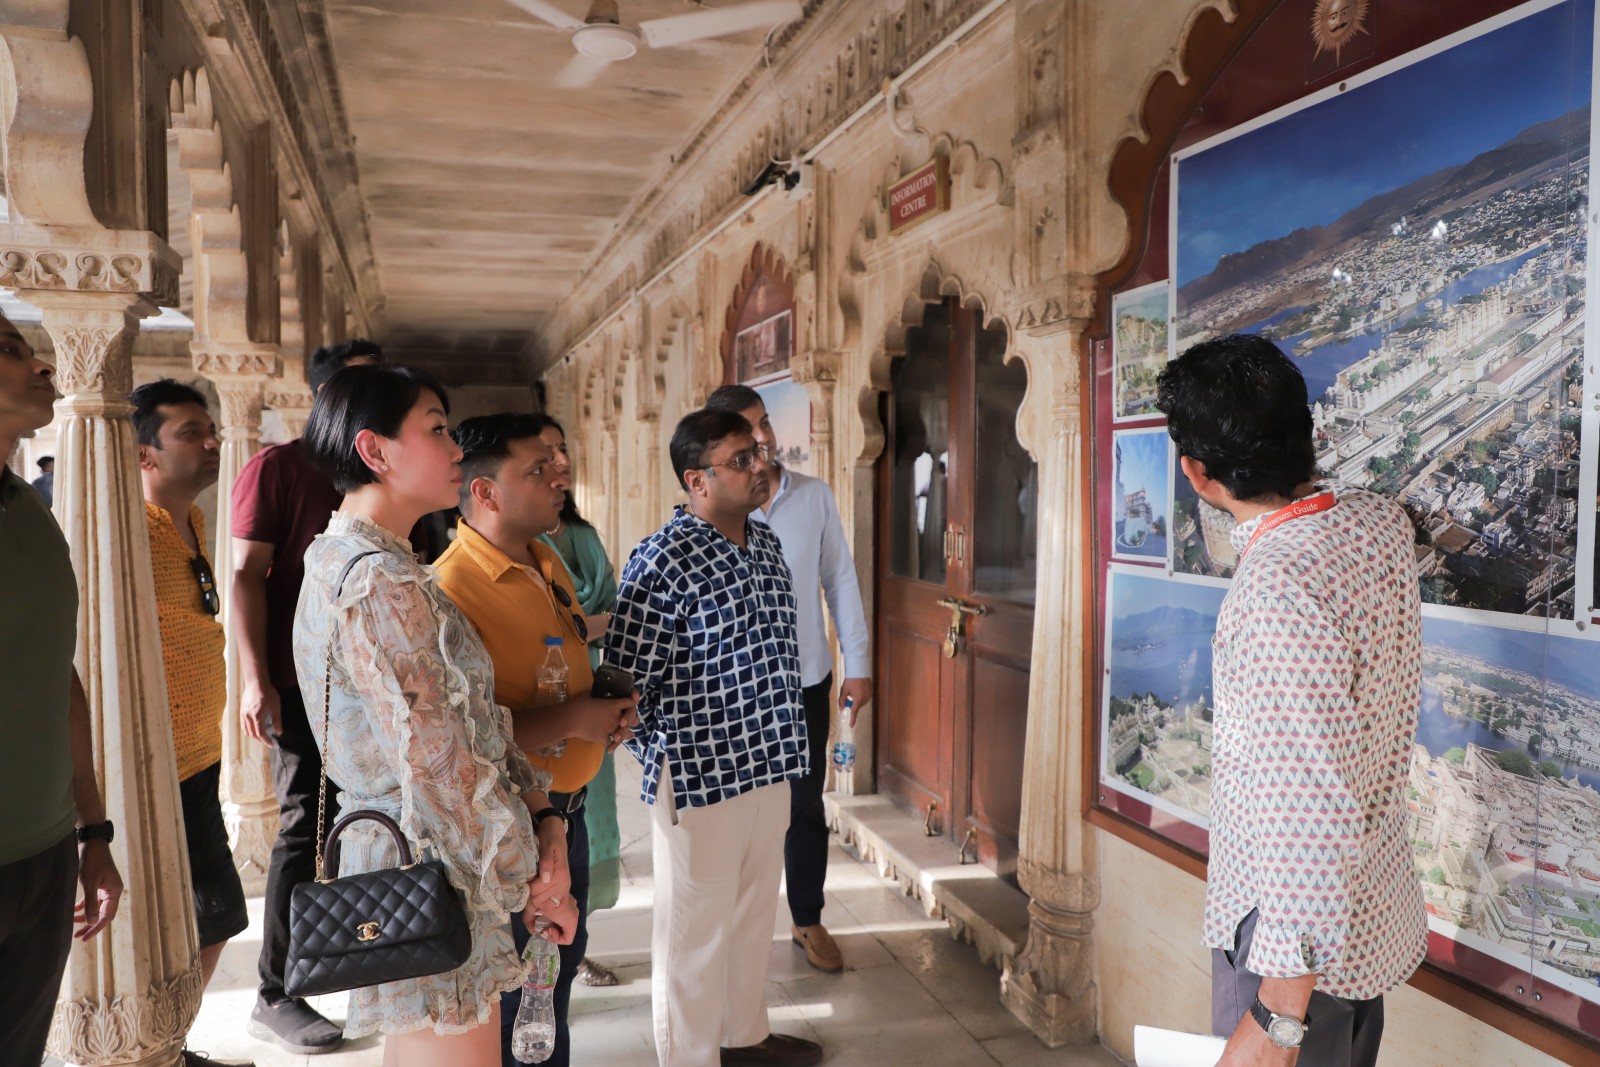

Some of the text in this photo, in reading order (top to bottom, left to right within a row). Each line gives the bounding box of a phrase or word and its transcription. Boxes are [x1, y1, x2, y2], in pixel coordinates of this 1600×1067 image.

[891, 172, 936, 206] INFORMATION
[900, 194, 927, 218] CENTRE
[1259, 503, 1318, 533] Museum Guide
